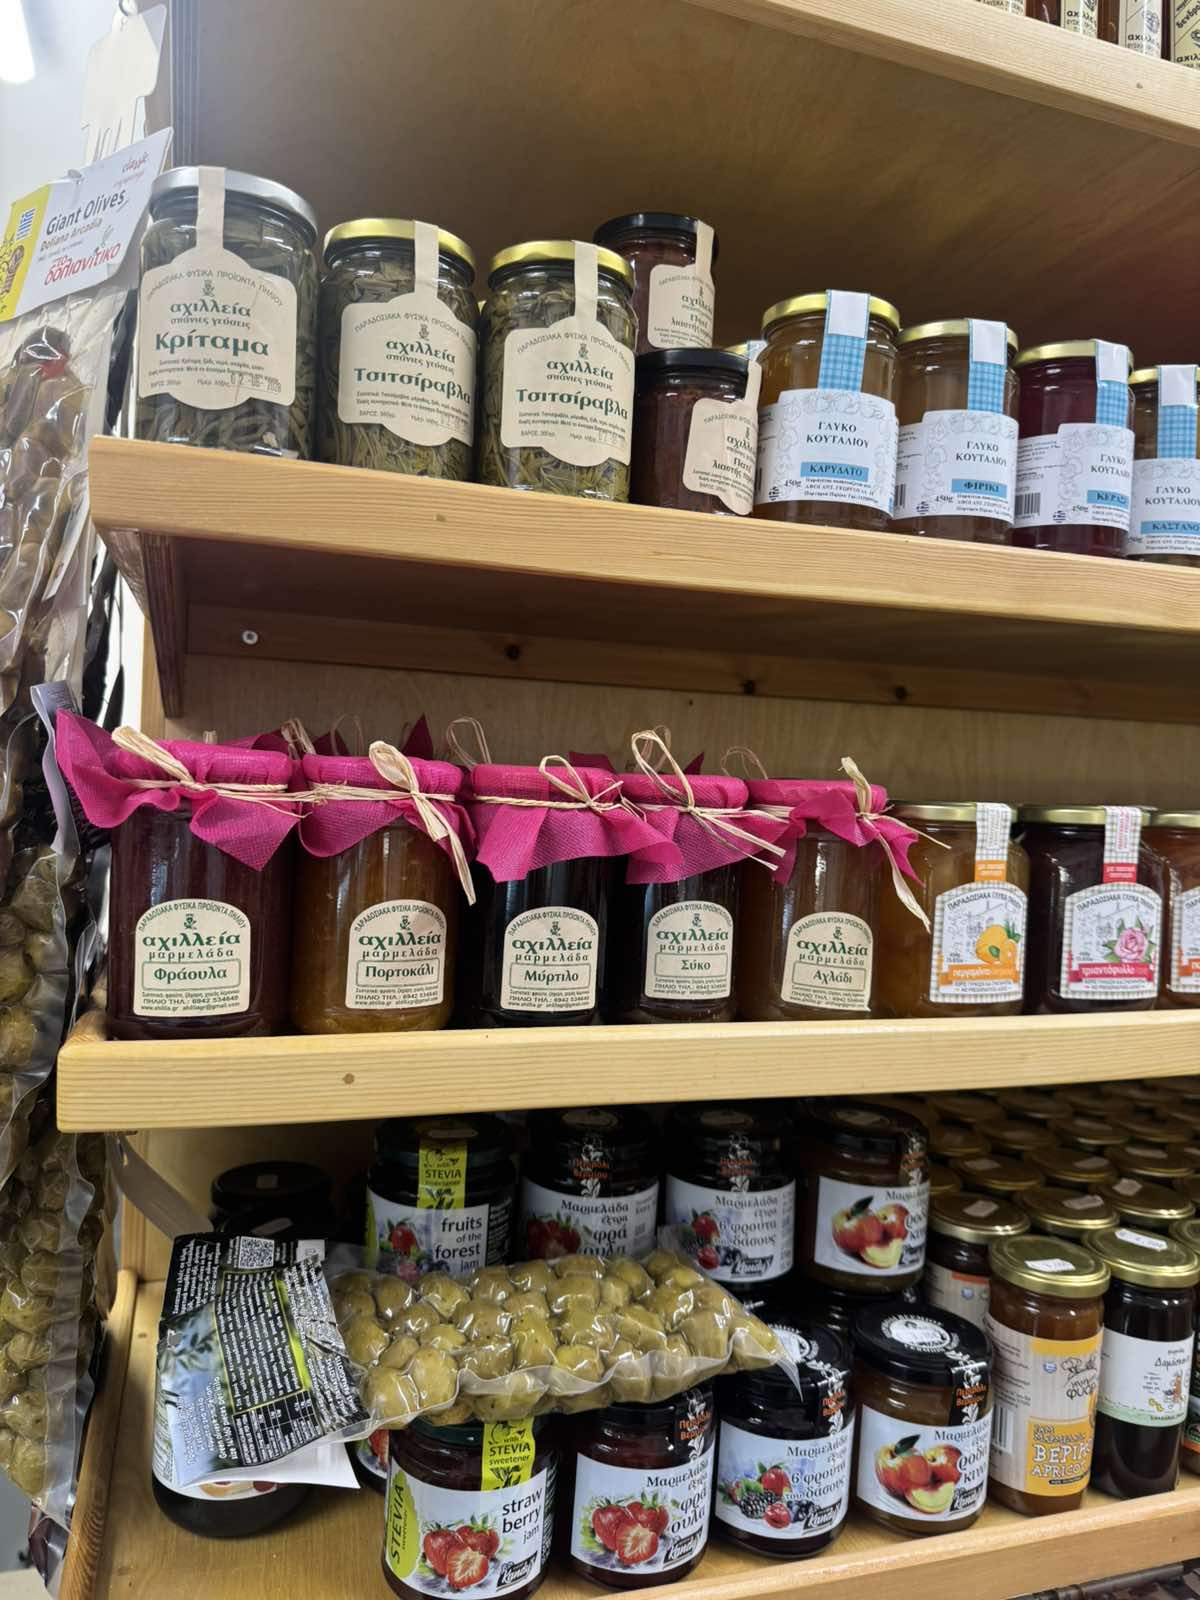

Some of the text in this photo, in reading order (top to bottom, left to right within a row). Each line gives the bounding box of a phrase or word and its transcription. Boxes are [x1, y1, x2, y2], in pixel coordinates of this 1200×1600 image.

[46, 189, 127, 236] Giant Olives
[170, 299, 251, 317] αχιλλεία
[155, 328, 269, 357] Κρίταμα
[385, 340, 456, 364] αχιλλεία
[546, 360, 614, 380] αχιλλεία
[354, 367, 471, 405] Τσιτσίραβλα
[516, 388, 628, 421] Τσιτσίραβλα
[818, 421, 857, 433] ΓΛΥΚΟ
[806, 434, 870, 449] ΚΟΥΤΑΛΙΟΥ
[967, 440, 999, 452] ΓΛΥΚΟ
[1100, 454, 1126, 465] ΓΛΥΚΟ
[810, 463, 863, 477] ΚΑΡΥΔΑΤΟ
[964, 481, 1000, 493] ΦΙΡΙΚΙ
[1155, 486, 1191, 494] ΓΛΥΚΟ
[174, 902, 196, 910] ΦΥΣΙΚΑ
[198, 902, 228, 915] ΠΡΟΪΟΝΤΑ
[143, 931, 240, 951] αχιλλεία
[358, 931, 441, 950] αχιλλεία
[656, 928, 728, 944] αχιλλεία
[362, 947, 437, 960] μαρμελάδα
[512, 937, 592, 954] αχιλλεία
[660, 943, 726, 954] μαρμελάδα
[796, 940, 868, 956] αχιλλεία
[149, 948, 233, 963] μαρμελάδα
[515, 953, 588, 965] μαρμελάδα
[799, 953, 864, 966] μαρμελάδα
[366, 963, 434, 981] Πορτοκάλι
[681, 959, 711, 970] Σύκο
[154, 966, 227, 984] Φράουλα
[524, 970, 579, 985] Μύρτιλο
[813, 970, 852, 984] Αχλάδι
[425, 1169, 462, 1178] STEVIA
[561, 1199, 629, 1214] Μαρμελάδα
[715, 1195, 778, 1209] Μαρμελάδα
[441, 1216, 482, 1232] fruits
[731, 1219, 777, 1236] φρούτα
[456, 1232, 481, 1243] of the
[593, 1224, 626, 1244] φρά
[434, 1243, 480, 1259] forest
[489, 1442, 531, 1456] STEVIA
[489, 1455, 530, 1465] sweetener
[647, 1460, 708, 1488] Μαρμελάδα
[792, 1461, 846, 1485] 6 φρούτα
[806, 1473, 845, 1499] δάσους
[502, 1488, 543, 1516] straw
[681, 1484, 707, 1512] φρά
[391, 1484, 404, 1563] STEVIA
[502, 1504, 541, 1533] berry
[671, 1508, 705, 1535] ουλα
[523, 1526, 540, 1544] jam
